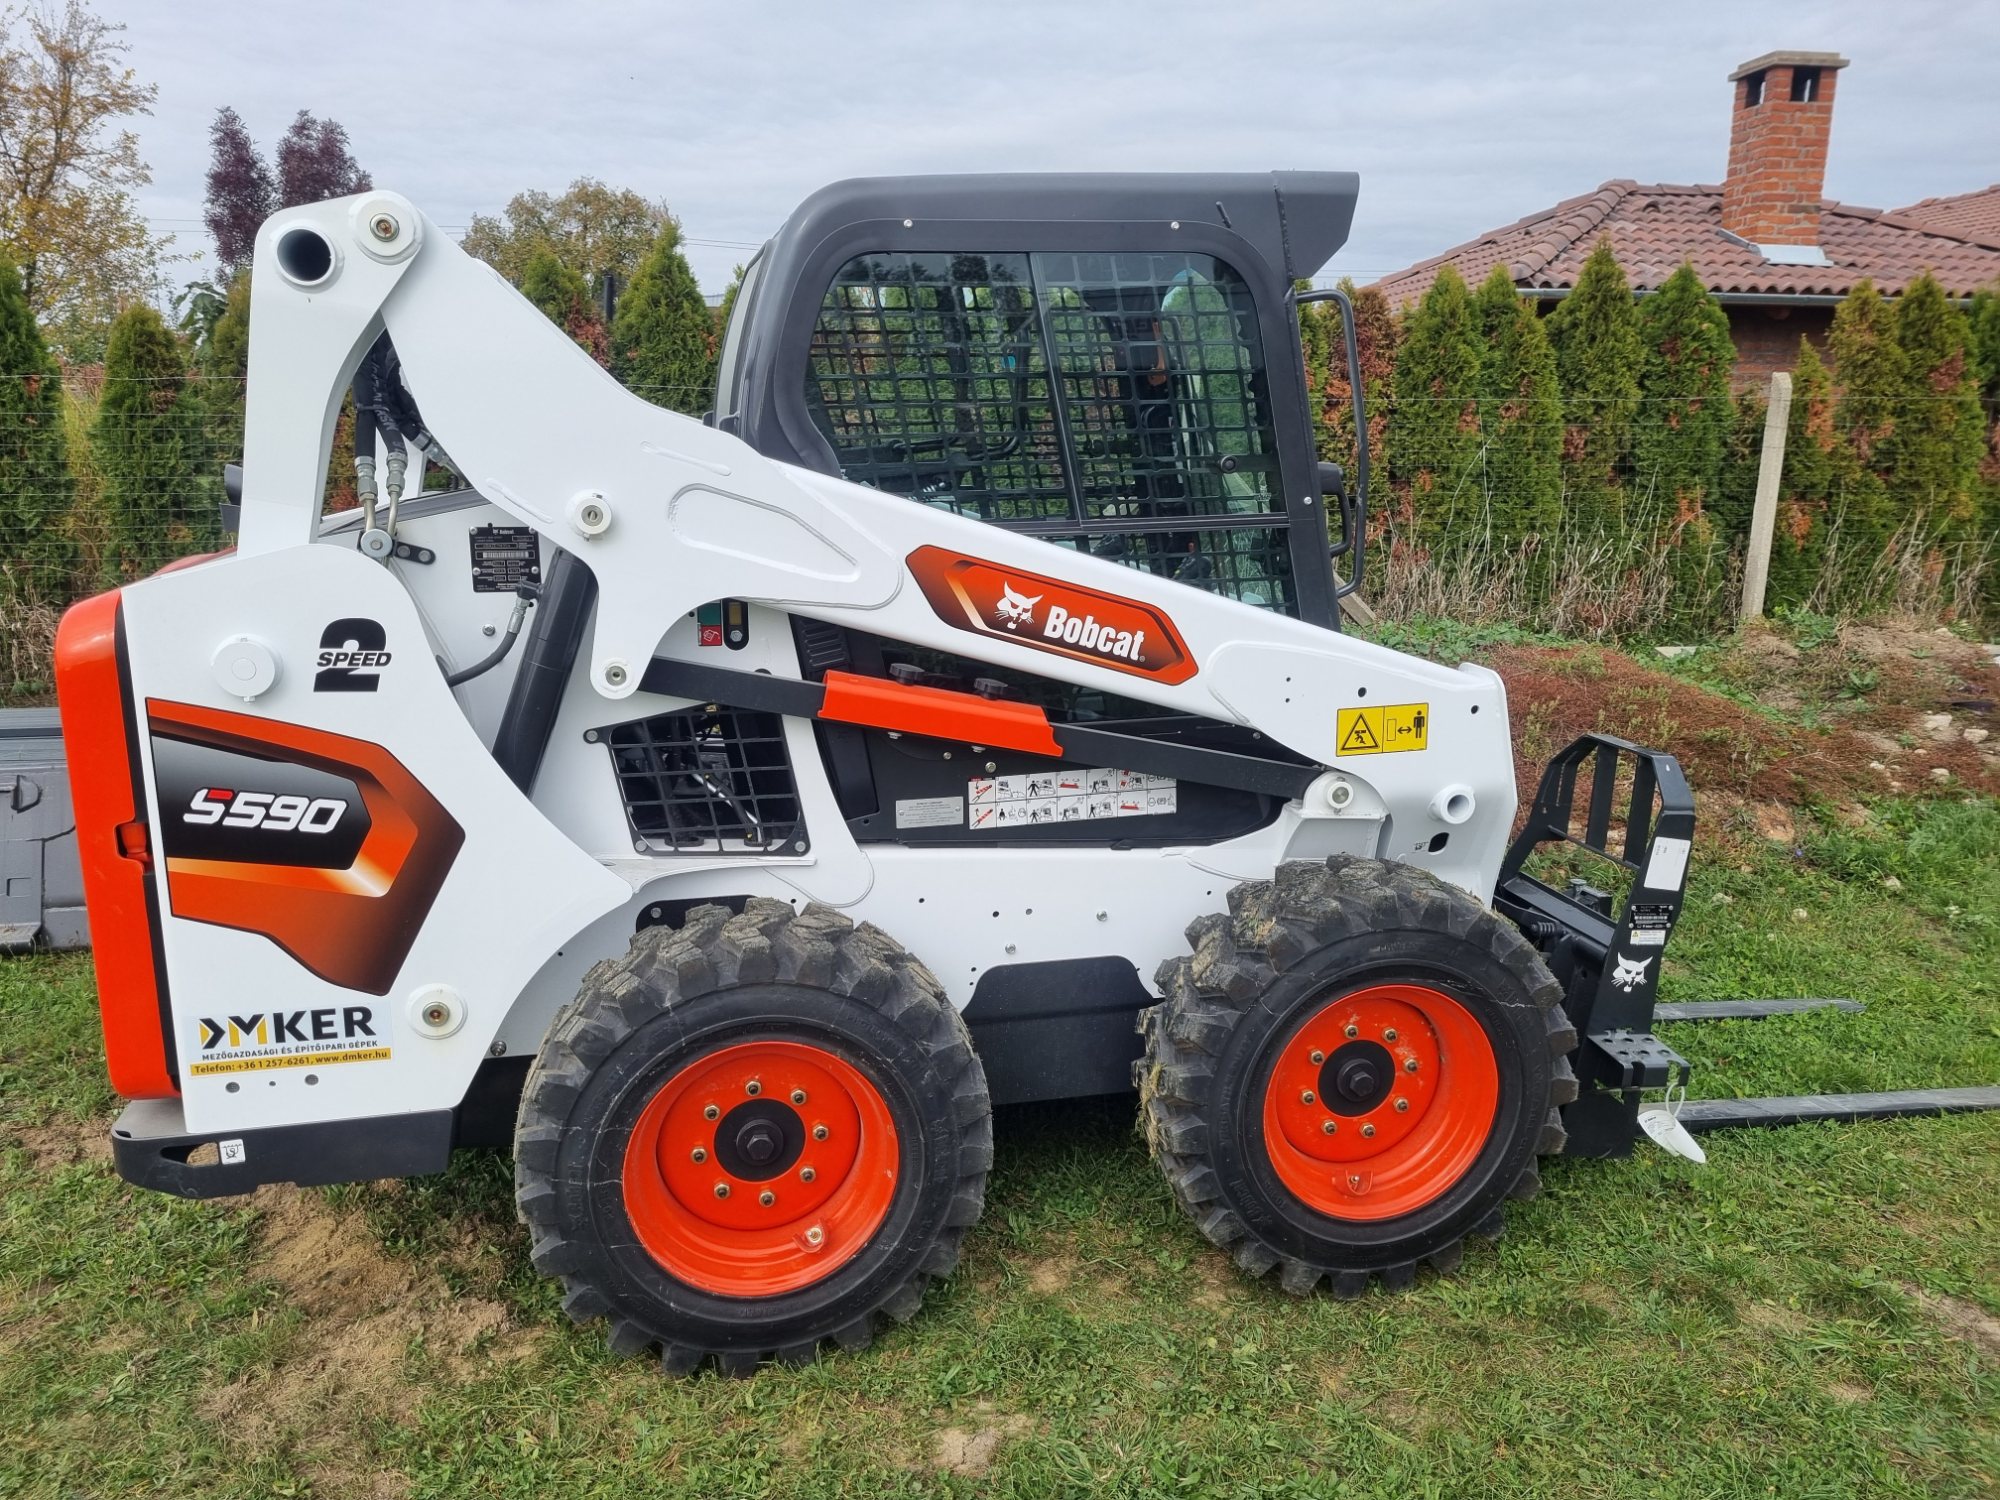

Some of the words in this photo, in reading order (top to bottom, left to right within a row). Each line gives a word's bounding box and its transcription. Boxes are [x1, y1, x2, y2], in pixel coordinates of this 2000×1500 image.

[313, 617, 387, 693] 2
[1043, 605, 1145, 661] Bobcat
[316, 651, 392, 667] SPEED
[183, 788, 348, 834] S590
[199, 1006, 377, 1050] DMKER
[195, 1064, 235, 1074] Telefon:
[238, 1061, 256, 1071] +36
[266, 1056, 314, 1068] 257-6261,
[316, 1050, 388, 1064] www.dmker.hu
[202, 1048, 279, 1061] MEZŐGAZDASÁGI
[281, 1046, 293, 1054] ÉS
[295, 1042, 346, 1053] ÉPÍTŐIPARI
[348, 1040, 379, 1049] GÉPEK
